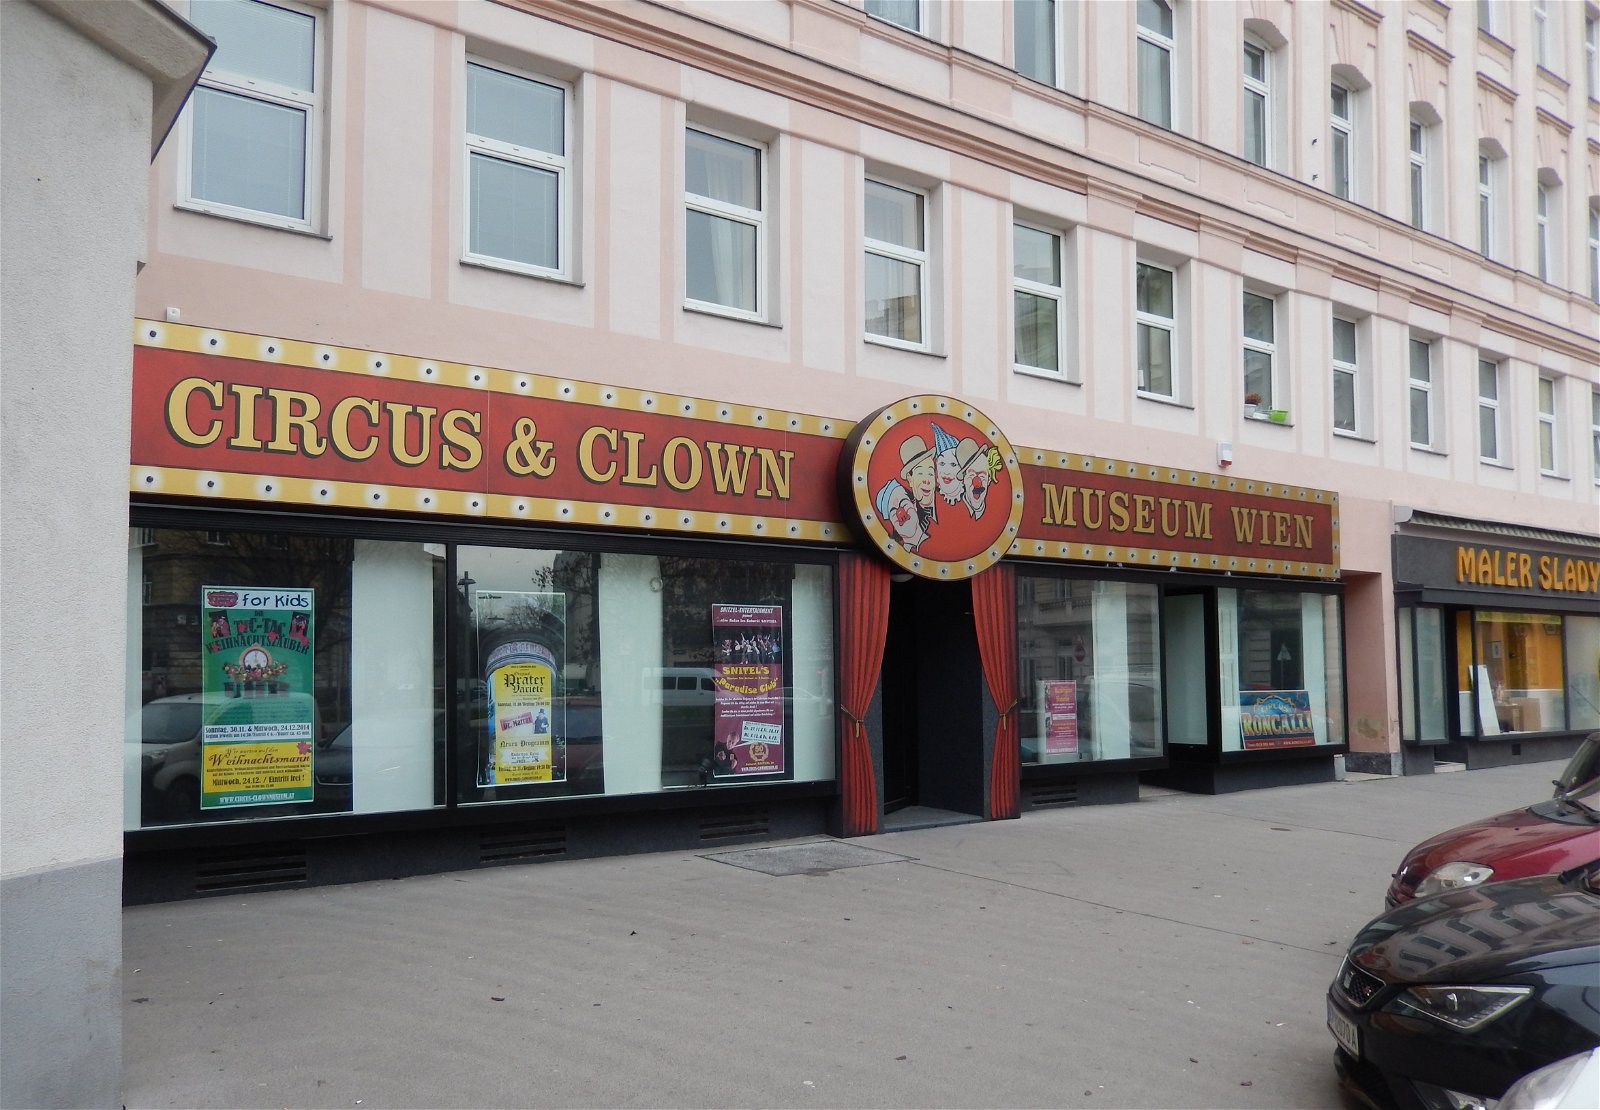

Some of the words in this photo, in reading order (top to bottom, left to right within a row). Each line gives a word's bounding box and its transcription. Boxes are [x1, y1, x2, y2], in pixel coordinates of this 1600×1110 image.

[163, 376, 484, 472] CIRCUS
[504, 417, 557, 481] &
[576, 425, 795, 500] CLOWN
[1041, 483, 1213, 540] MUSEUM
[1230, 506, 1314, 549] WIEN
[1456, 546, 1533, 588] MALER
[1538, 555, 1600, 593] SLADY
[243, 593, 271, 606] for
[275, 594, 309, 608] Kids
[503, 673, 546, 688] Prater
[1241, 710, 1314, 736] RONCALLI
[208, 753, 310, 767] Weihnachtsmann
